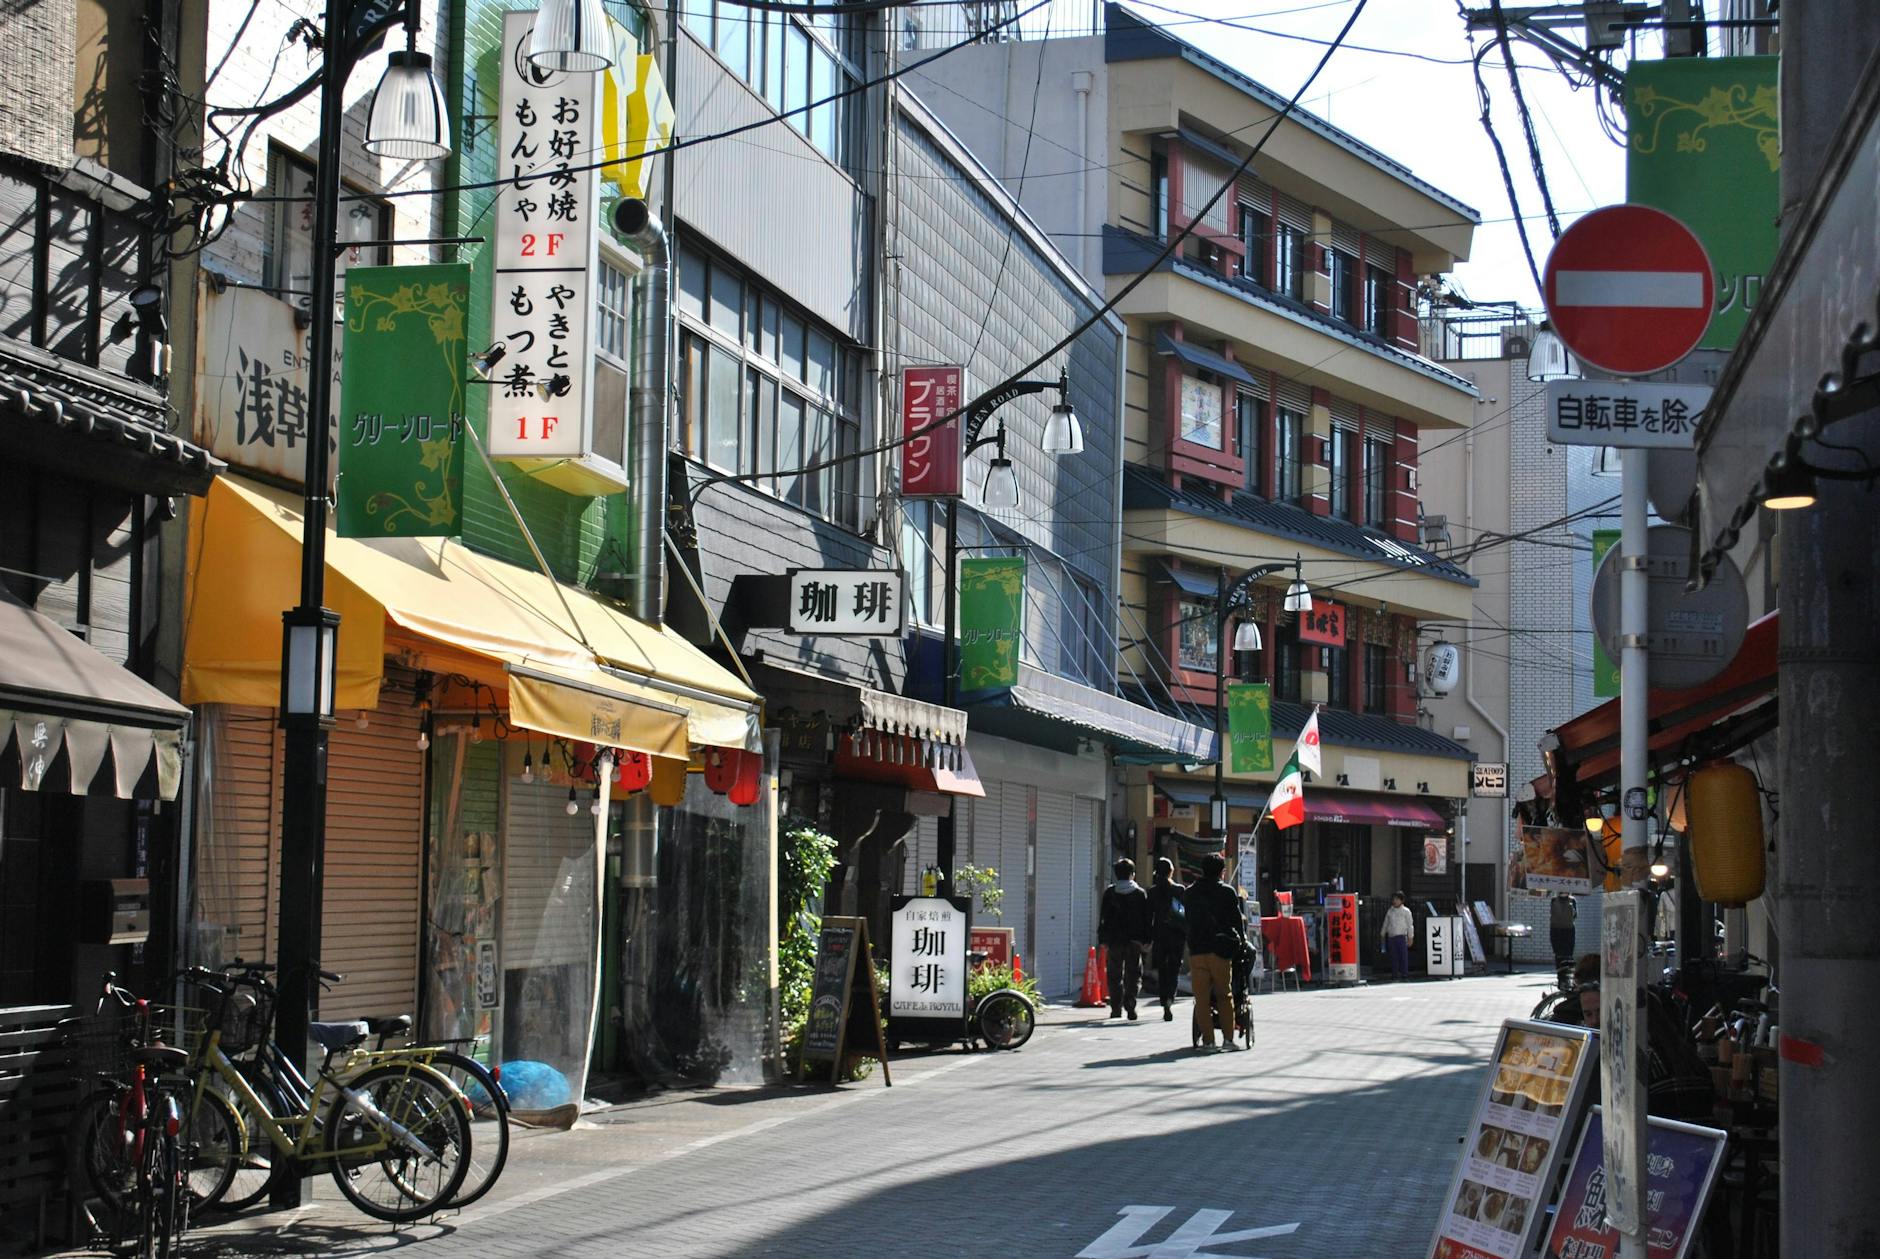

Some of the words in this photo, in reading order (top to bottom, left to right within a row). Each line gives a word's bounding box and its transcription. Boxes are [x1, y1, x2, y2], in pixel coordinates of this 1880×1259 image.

[511, 98, 540, 223] もんじゃ
[547, 96, 580, 223] お好み焼
[520, 233, 564, 257] 2F
[503, 285, 536, 399] もつ煮
[990, 388, 1019, 408] ROAD
[1557, 393, 1705, 435] 自転車を除く
[352, 411, 463, 447] グリーンロード
[516, 416, 559, 440] 1F
[798, 581, 893, 623] 珈琲
[1475, 776, 1505, 788] メヒコ
[906, 911, 952, 922] 自家焙煎
[911, 926, 946, 994] 珈琲
[1432, 926, 1442, 966] メヒコ
[893, 1001, 919, 1011] CAFE
